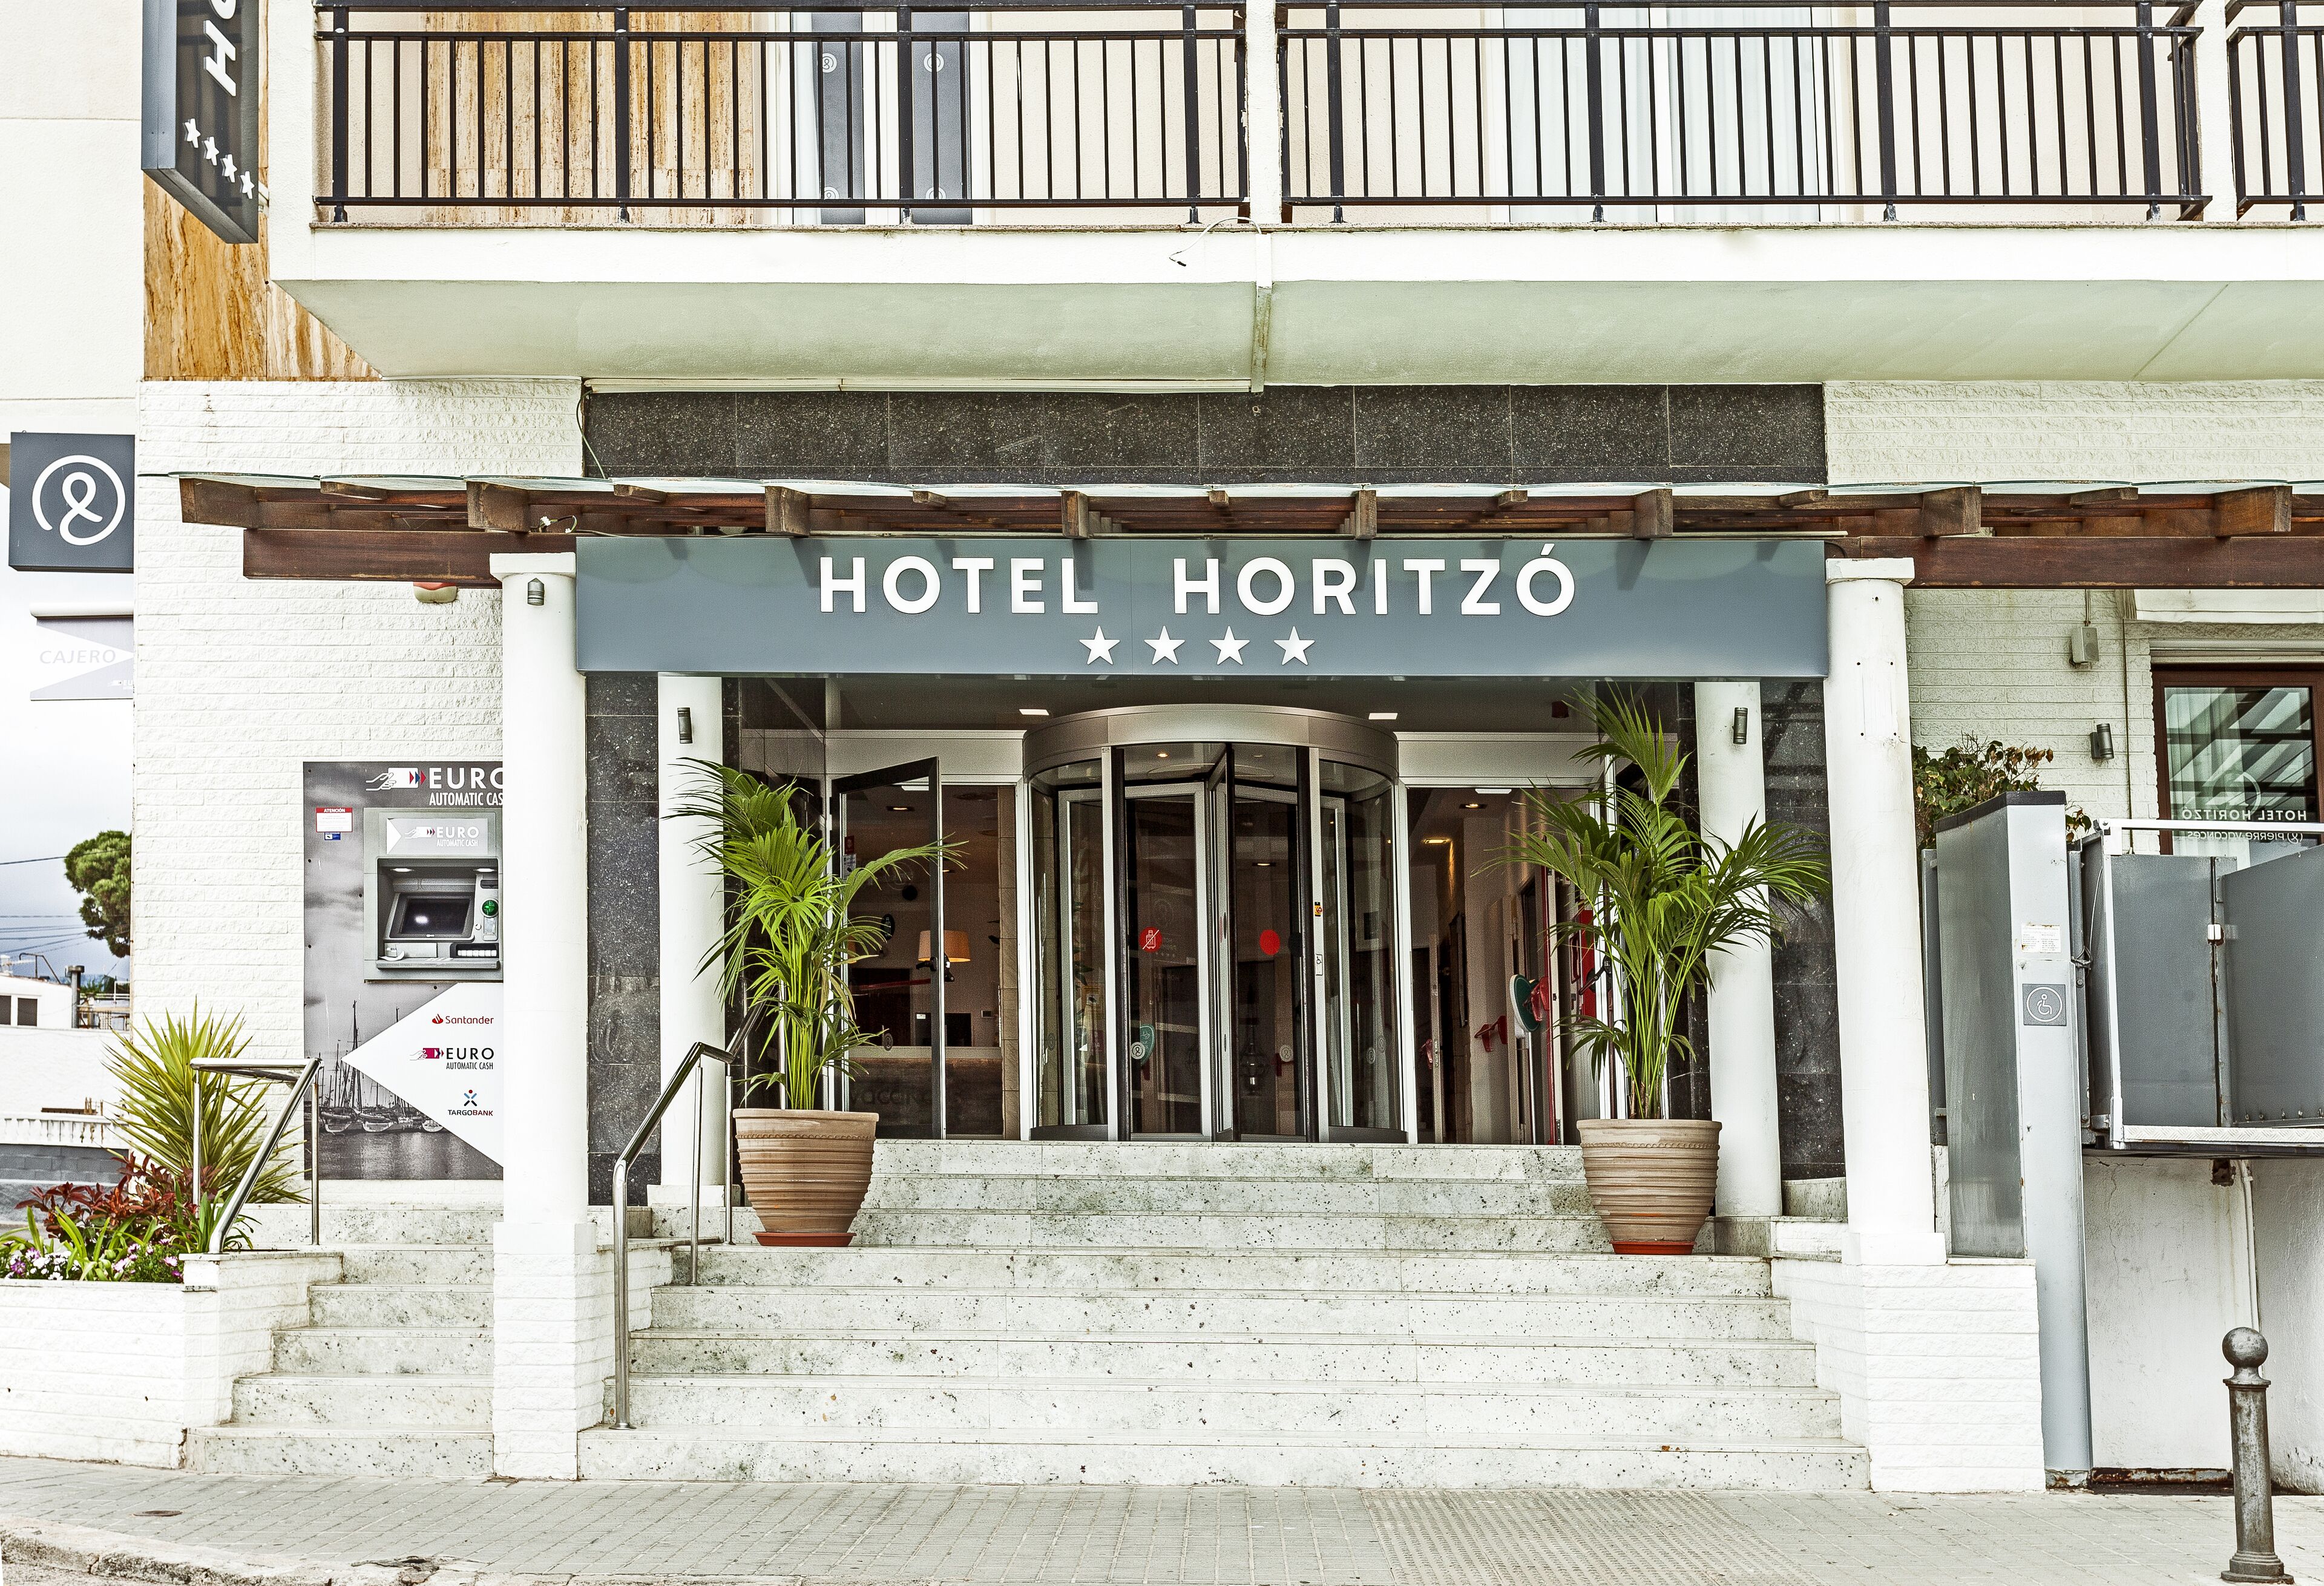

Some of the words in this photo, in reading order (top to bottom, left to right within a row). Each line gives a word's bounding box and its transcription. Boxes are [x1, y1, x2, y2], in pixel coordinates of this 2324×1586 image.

[819, 555, 1099, 615] HOTEL
[1173, 543, 1575, 617] HORITZÓ
[39, 649, 116, 664] CAJERO
[429, 767, 503, 790] EURO
[428, 792, 484, 806] AUTOMATIC
[486, 792, 503, 806] CAS
[436, 826, 479, 839] EURO
[445, 1015, 494, 1024] Santander
[446, 1047, 494, 1060] EURO
